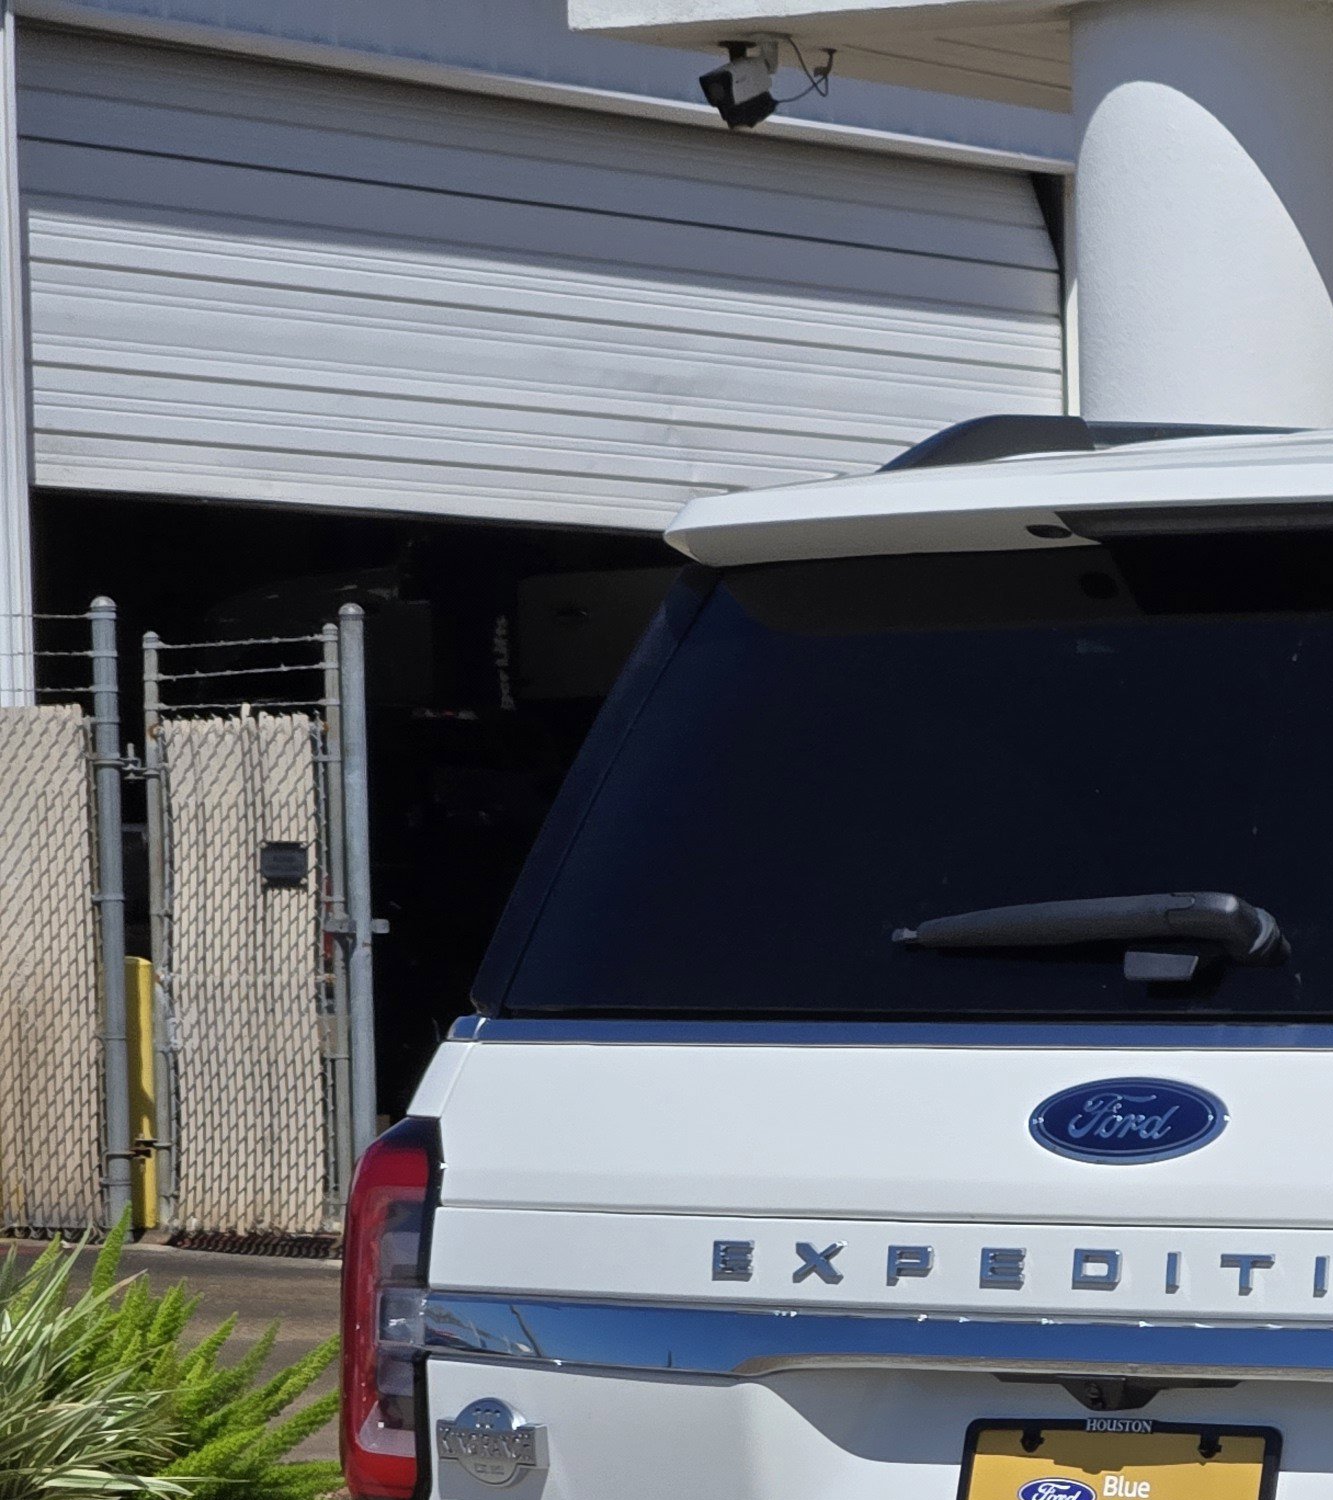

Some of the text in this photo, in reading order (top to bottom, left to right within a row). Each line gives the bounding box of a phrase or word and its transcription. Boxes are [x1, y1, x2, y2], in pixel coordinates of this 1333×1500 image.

[1066, 1090, 1182, 1141] Ford
[1085, 1417, 1153, 1434] HOUSTON
[1102, 1474, 1151, 1500] Blue
